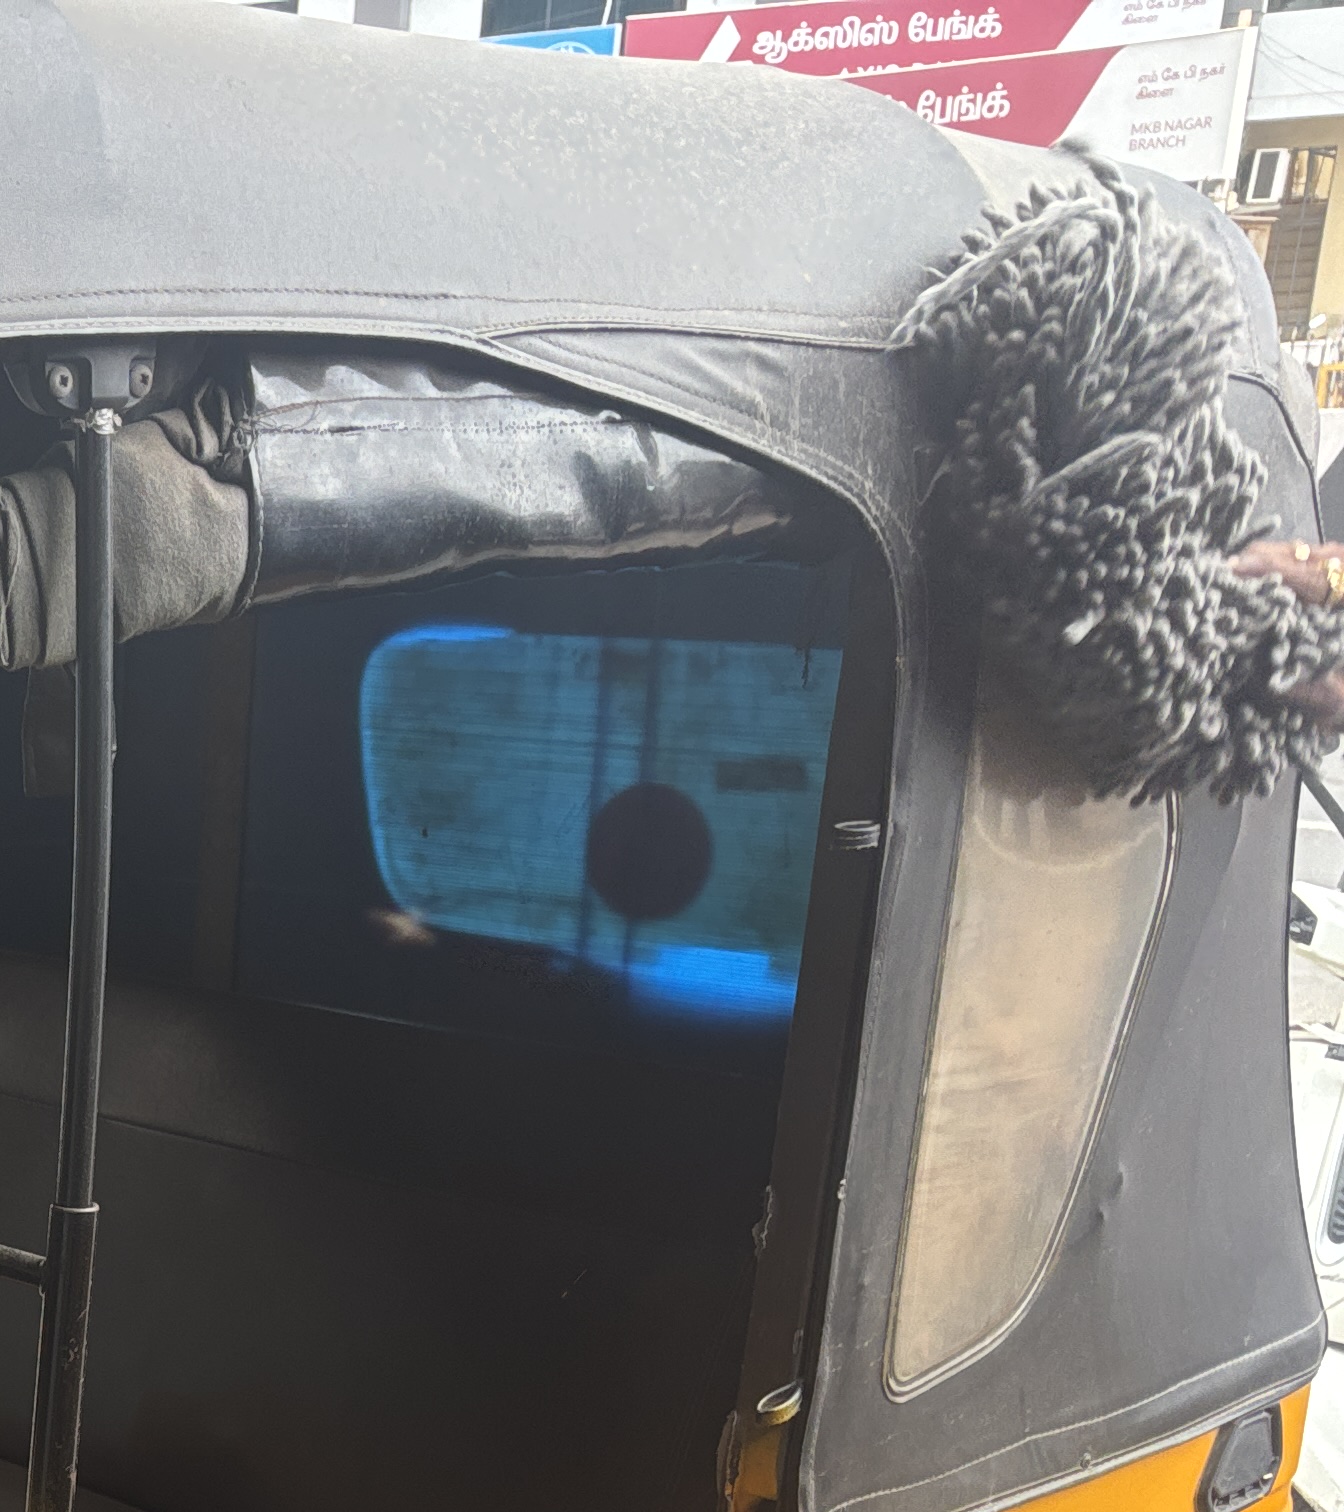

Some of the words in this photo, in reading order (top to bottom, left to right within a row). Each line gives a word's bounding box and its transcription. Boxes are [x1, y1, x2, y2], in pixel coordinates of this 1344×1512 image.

[752, 15, 899, 63] ஆக்ஸிஸ்
[907, 7, 1002, 42] பேங்க்
[1130, 121, 1162, 136] MKB
[1164, 116, 1213, 131] NAGAR
[1128, 135, 1186, 151] BRANCH
